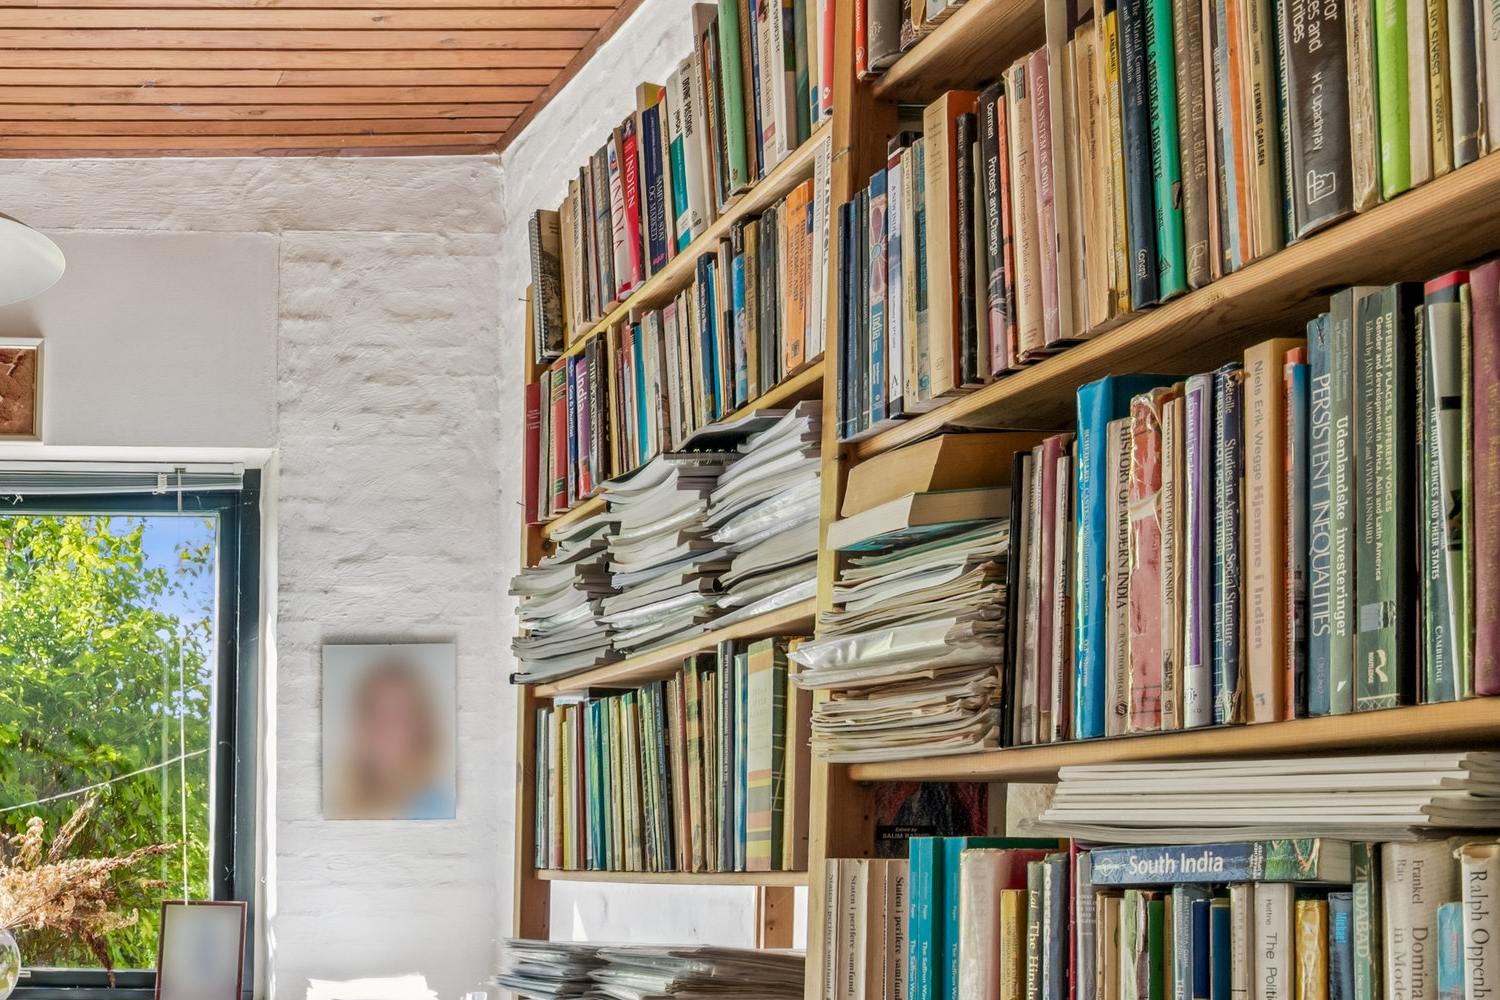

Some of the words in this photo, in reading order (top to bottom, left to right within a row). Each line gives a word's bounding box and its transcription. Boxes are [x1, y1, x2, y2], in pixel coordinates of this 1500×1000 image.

[986, 102, 995, 139] Oommen
[1253, 83, 1263, 124] FLEMMING
[1254, 128, 1265, 166] CARLSEN
[625, 153, 636, 208] INDIEN
[987, 157, 998, 195] Protest
[990, 197, 998, 216] and
[989, 218, 1000, 256] Change
[1375, 316, 1383, 352] Gender
[1384, 312, 1393, 369] DIFFERENT
[1253, 360, 1264, 398] Niels
[1375, 354, 1383, 370] and
[1374, 372, 1384, 431] development
[1383, 371, 1393, 414] PLACES,
[1253, 400, 1264, 427] Erik
[1311, 373, 1331, 491] PERSISTENT
[1118, 425, 1130, 485] HISTORY
[1252, 430, 1264, 481] Wegge
[1376, 433, 1384, 442] in
[1384, 415, 1393, 472] DIFFERENT
[1224, 439, 1236, 480] Studies
[1334, 414, 1350, 521] Udenlandske
[1375, 443, 1384, 474] Africa,
[1225, 483, 1236, 495] in
[1376, 476, 1384, 493] Asia
[1385, 474, 1393, 513] VOICES
[1431, 460, 1439, 497] PRINCES
[1120, 489, 1129, 514] OF
[1163, 481, 1173, 550] DEVELOPMENT
[1375, 498, 1383, 515] and
[1430, 500, 1439, 518] AND
[1117, 514, 1132, 573] MODERN
[1223, 501, 1236, 550] Agrarian
[1250, 485, 1266, 568] Hjemme
[1375, 516, 1383, 541] Latin
[1431, 521, 1439, 547] THEIR
[1164, 554, 1173, 605] PLANNING
[1226, 557, 1236, 589] Social
[1309, 500, 1331, 638] INEQUALITIES
[1375, 542, 1384, 581] America
[1431, 549, 1440, 580] STATES
[1116, 573, 1129, 609] INDIA
[1333, 527, 1348, 637] investeringer
[1225, 592, 1237, 647] Structure
[1254, 586, 1265, 649] Indien
[1434, 625, 1443, 683] CAMBRIDGE
[1128, 855, 1177, 877] South
[1180, 852, 1224, 875] India
[1412, 859, 1424, 904] Frankel
[1030, 890, 1039, 910] Lal
[1265, 899, 1273, 925] Hettne
[1354, 865, 1370, 959] ZINDABAD
[1466, 870, 1489, 921] Ralph
[1028, 921, 1040, 951] The
[1266, 932, 1277, 959] The
[1336, 912, 1347, 943] Michael
[1393, 928, 1406, 944] in
[1027, 955, 1039, 1000] Hindu
